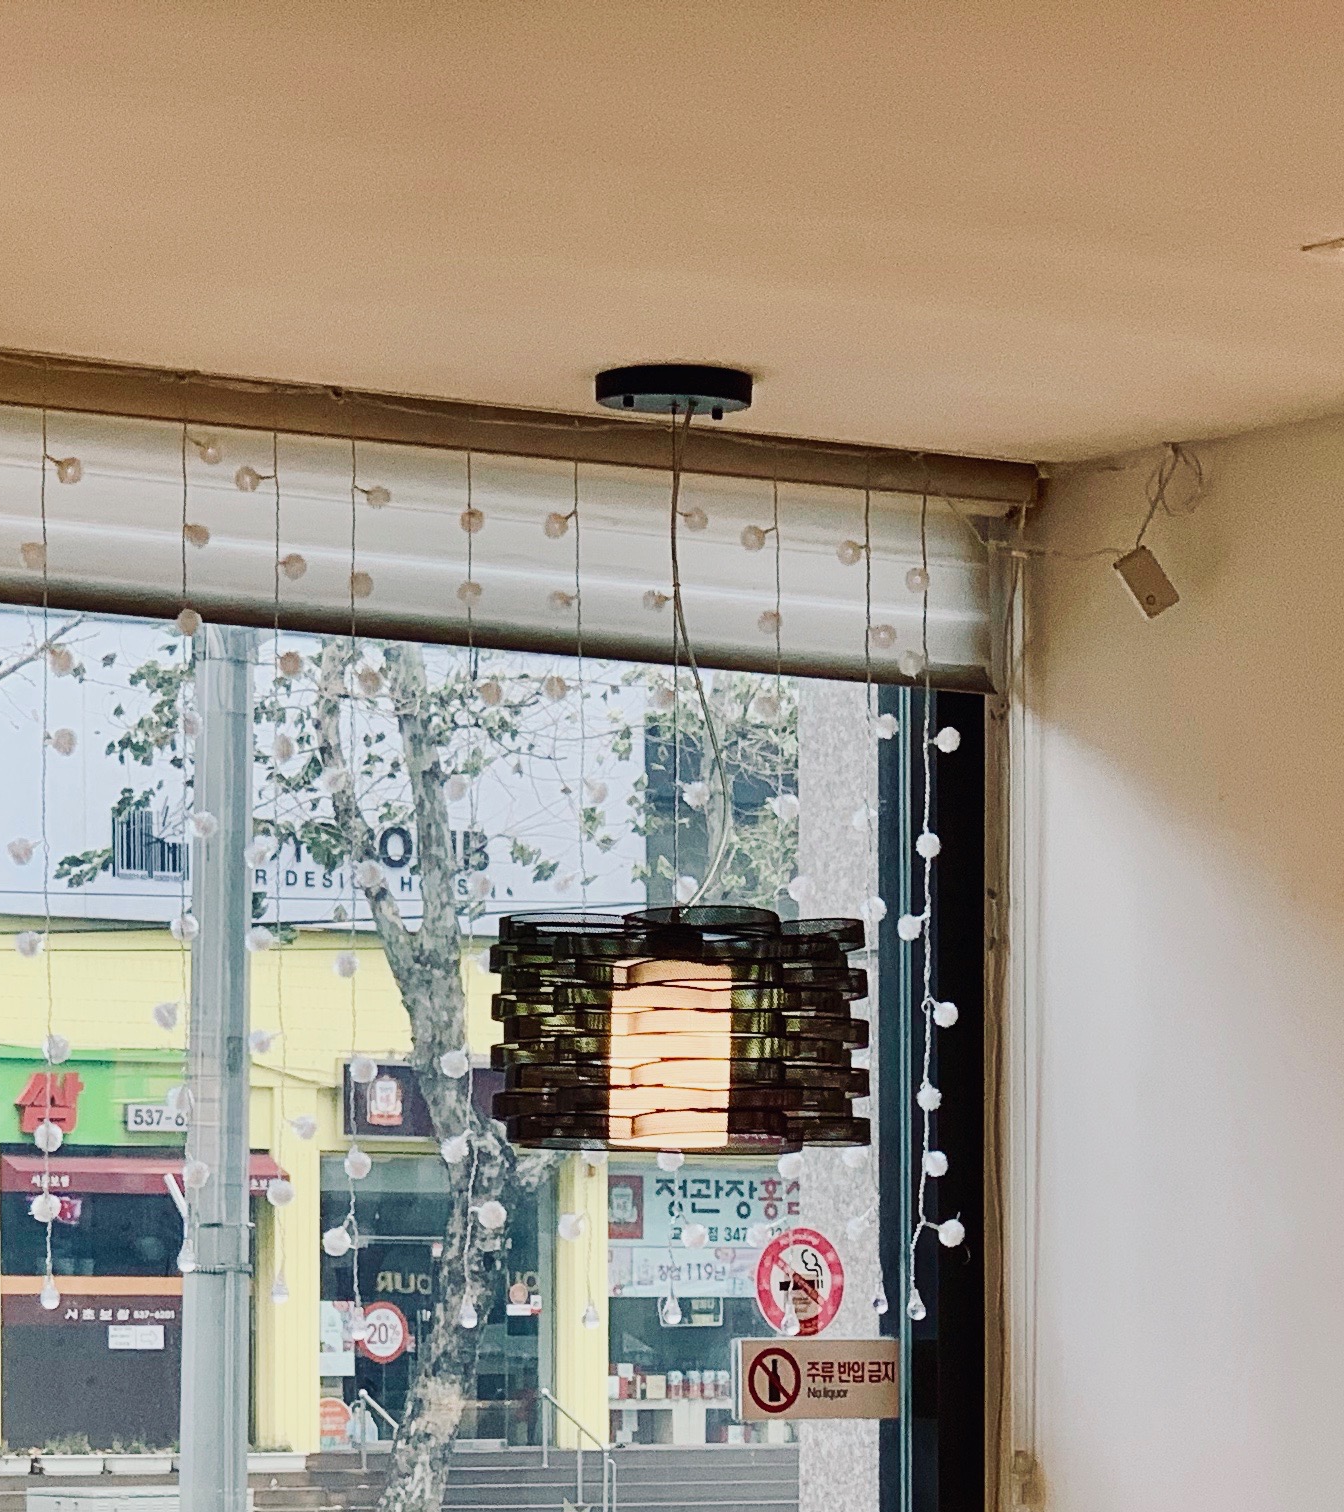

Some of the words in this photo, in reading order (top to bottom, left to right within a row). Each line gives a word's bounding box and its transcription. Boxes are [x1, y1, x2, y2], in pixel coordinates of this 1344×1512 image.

[286, 869, 360, 890] DESI
[133, 1109, 188, 1127] 537-6
[671, 1226, 719, 1242] 교점
[806, 1361, 835, 1383] 주류
[837, 1361, 865, 1383] 반입
[867, 1361, 895, 1383] 금지
